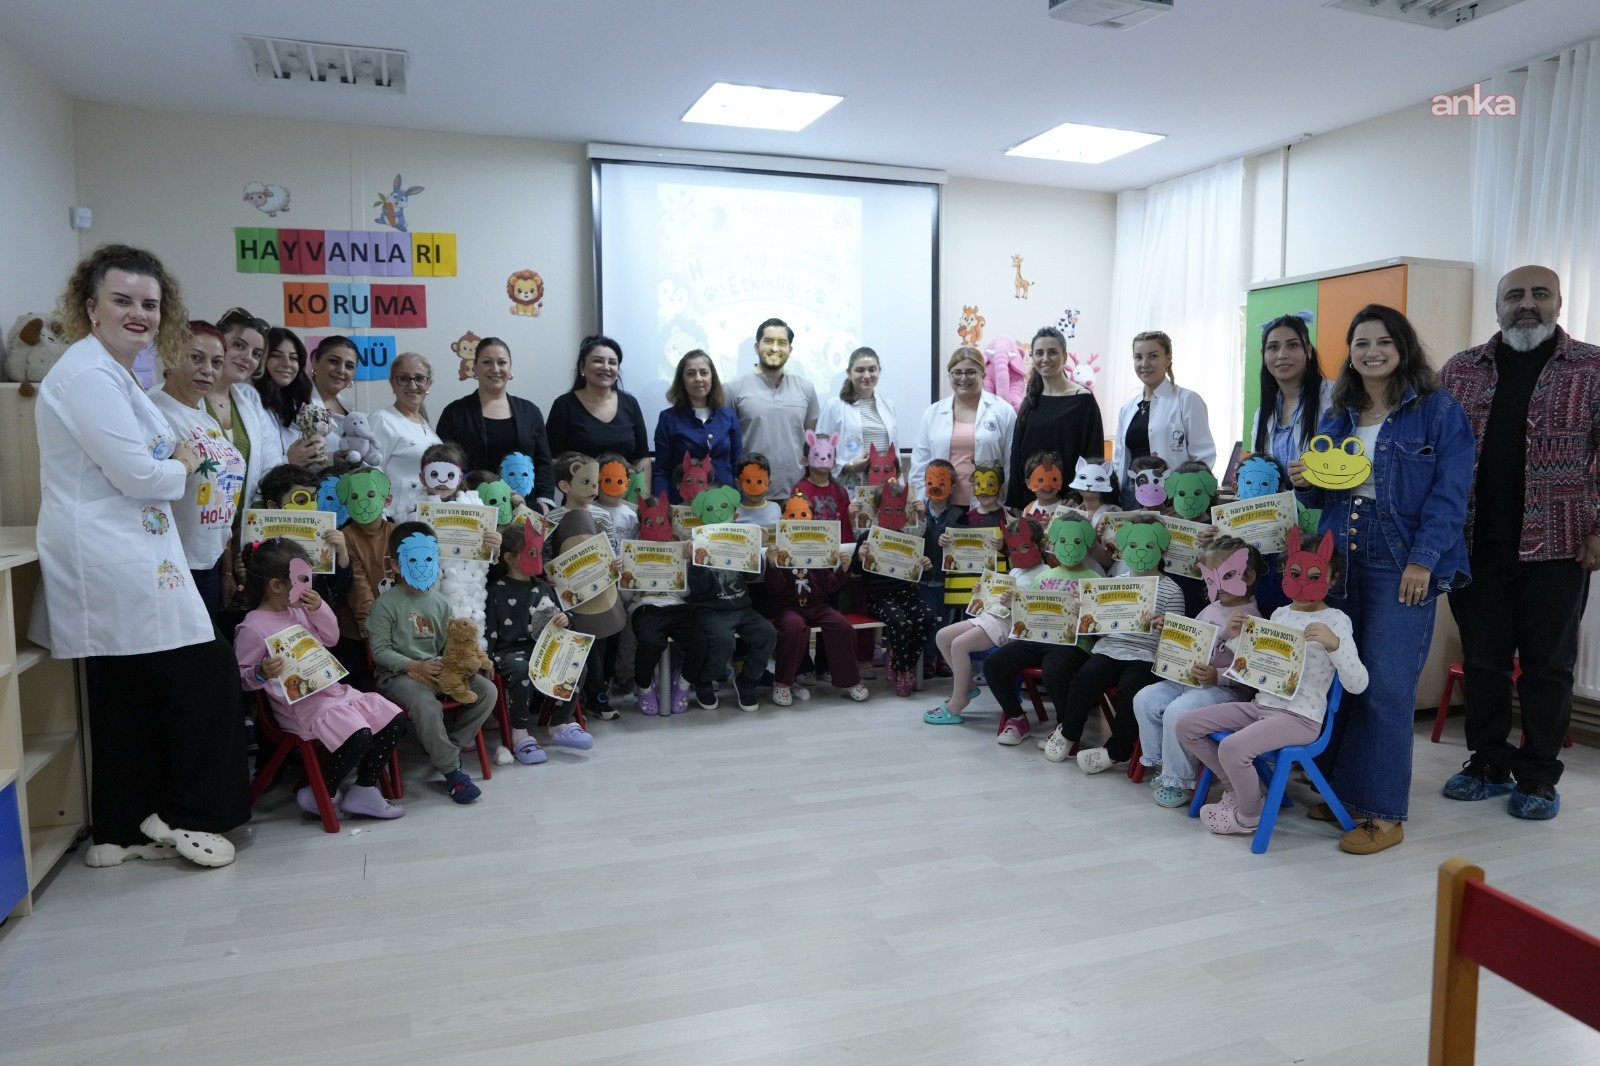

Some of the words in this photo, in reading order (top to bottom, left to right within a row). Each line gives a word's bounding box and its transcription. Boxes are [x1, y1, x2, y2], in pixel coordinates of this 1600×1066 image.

[240, 238, 441, 264] HAYVANLARI
[287, 293, 417, 316] KORUMA
[356, 342, 388, 367] NÜ
[264, 516, 292, 524] HAYVAN
